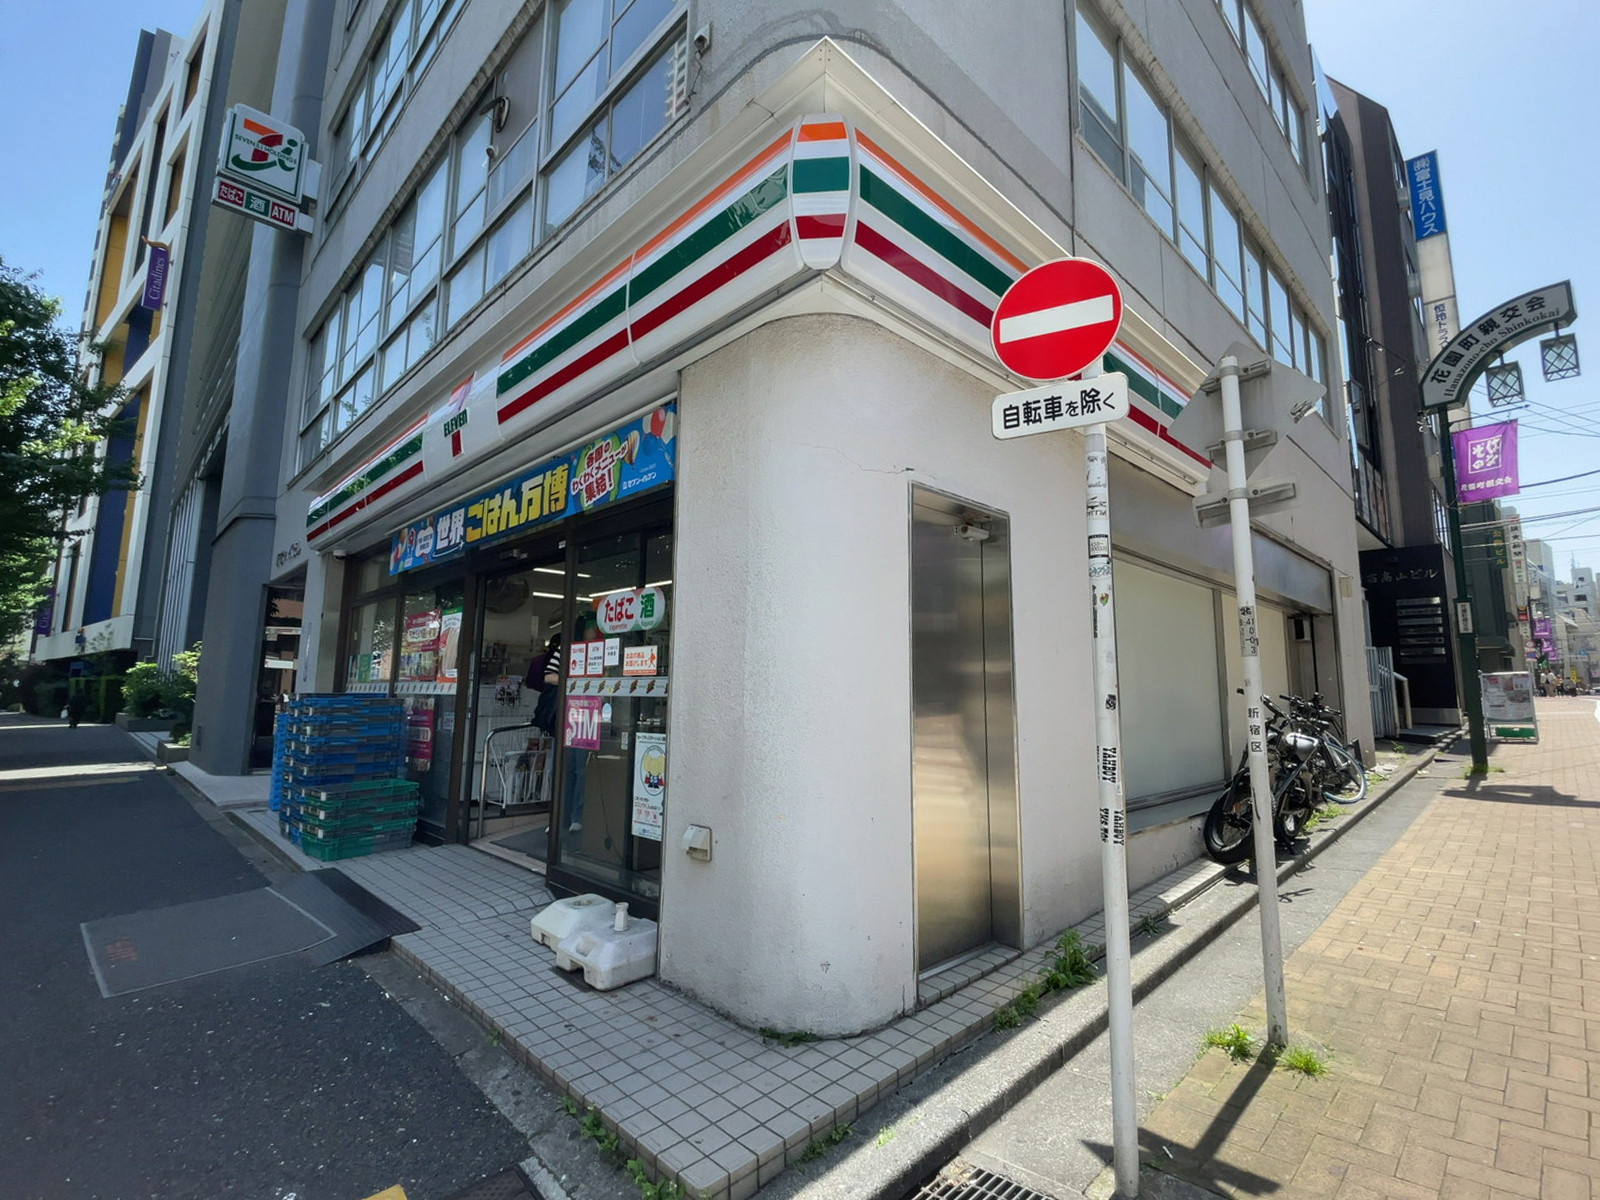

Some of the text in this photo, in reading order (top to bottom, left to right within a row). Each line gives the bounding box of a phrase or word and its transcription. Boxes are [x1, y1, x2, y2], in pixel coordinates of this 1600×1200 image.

[220, 184, 244, 204] たばこ
[271, 206, 295, 224] ATM
[147, 255, 165, 301] Citadines
[1430, 296, 1546, 386] 花園町親交会
[1443, 307, 1561, 398] Hanazono-cho Shinkokai
[1003, 388, 1116, 430] 自転車を除く
[604, 593, 655, 624] たばこ 酒
[567, 707, 598, 741] SIM
[1248, 707, 1263, 752] 新宿区
[1102, 747, 1118, 784] YAHBOY
[1113, 808, 1126, 847] YAHBOY
